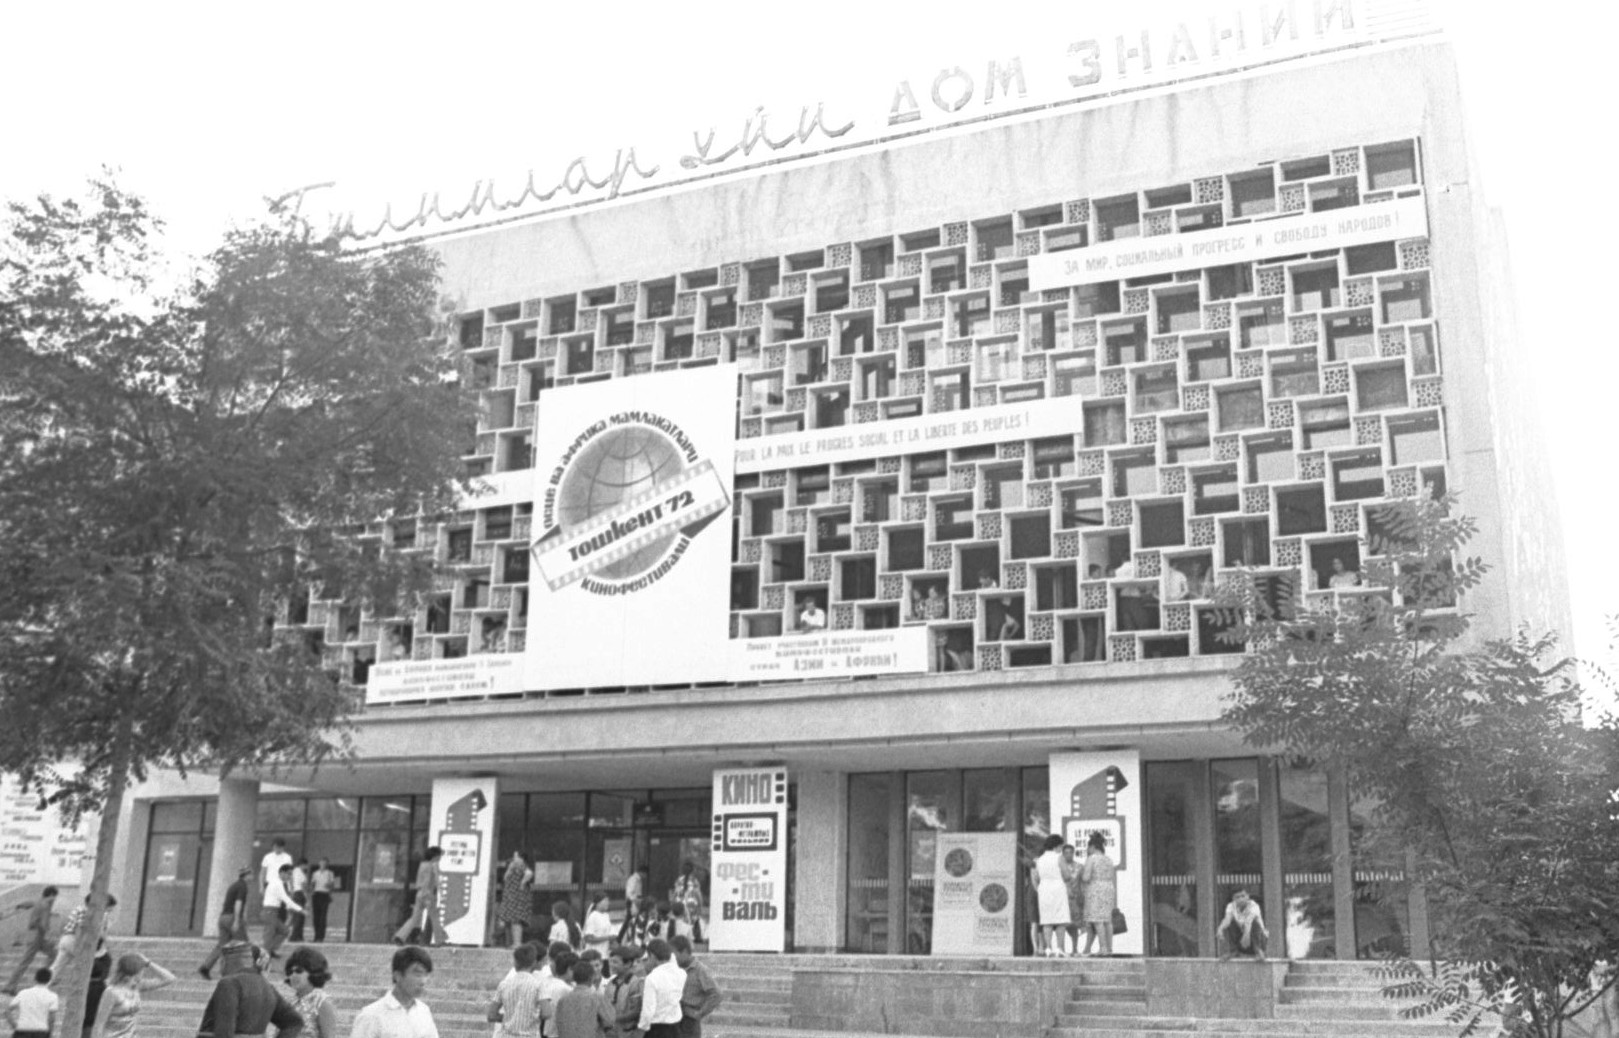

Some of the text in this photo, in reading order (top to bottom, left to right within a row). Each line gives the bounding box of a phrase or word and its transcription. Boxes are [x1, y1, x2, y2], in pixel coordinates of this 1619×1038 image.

[887, 55, 1029, 127] ДОМ
[1064, 260, 1081, 276] ЗА
[1115, 243, 1184, 267] СОЦИАЛЬНЫЙ
[1192, 236, 1246, 257] ПРОГРЕСС
[1255, 234, 1264, 247] И
[1273, 225, 1328, 245] СВОБОДУ
[734, 445, 756, 464] POUR
[761, 447, 774, 461] LA
[799, 442, 811, 456] LE
[859, 433, 888, 449] SOCIAL
[892, 429, 906, 445] ET
[907, 426, 921, 442] LA
[962, 421, 979, 438] DES
[664, 490, 695, 513] 72
[722, 773, 772, 805] КИНО
